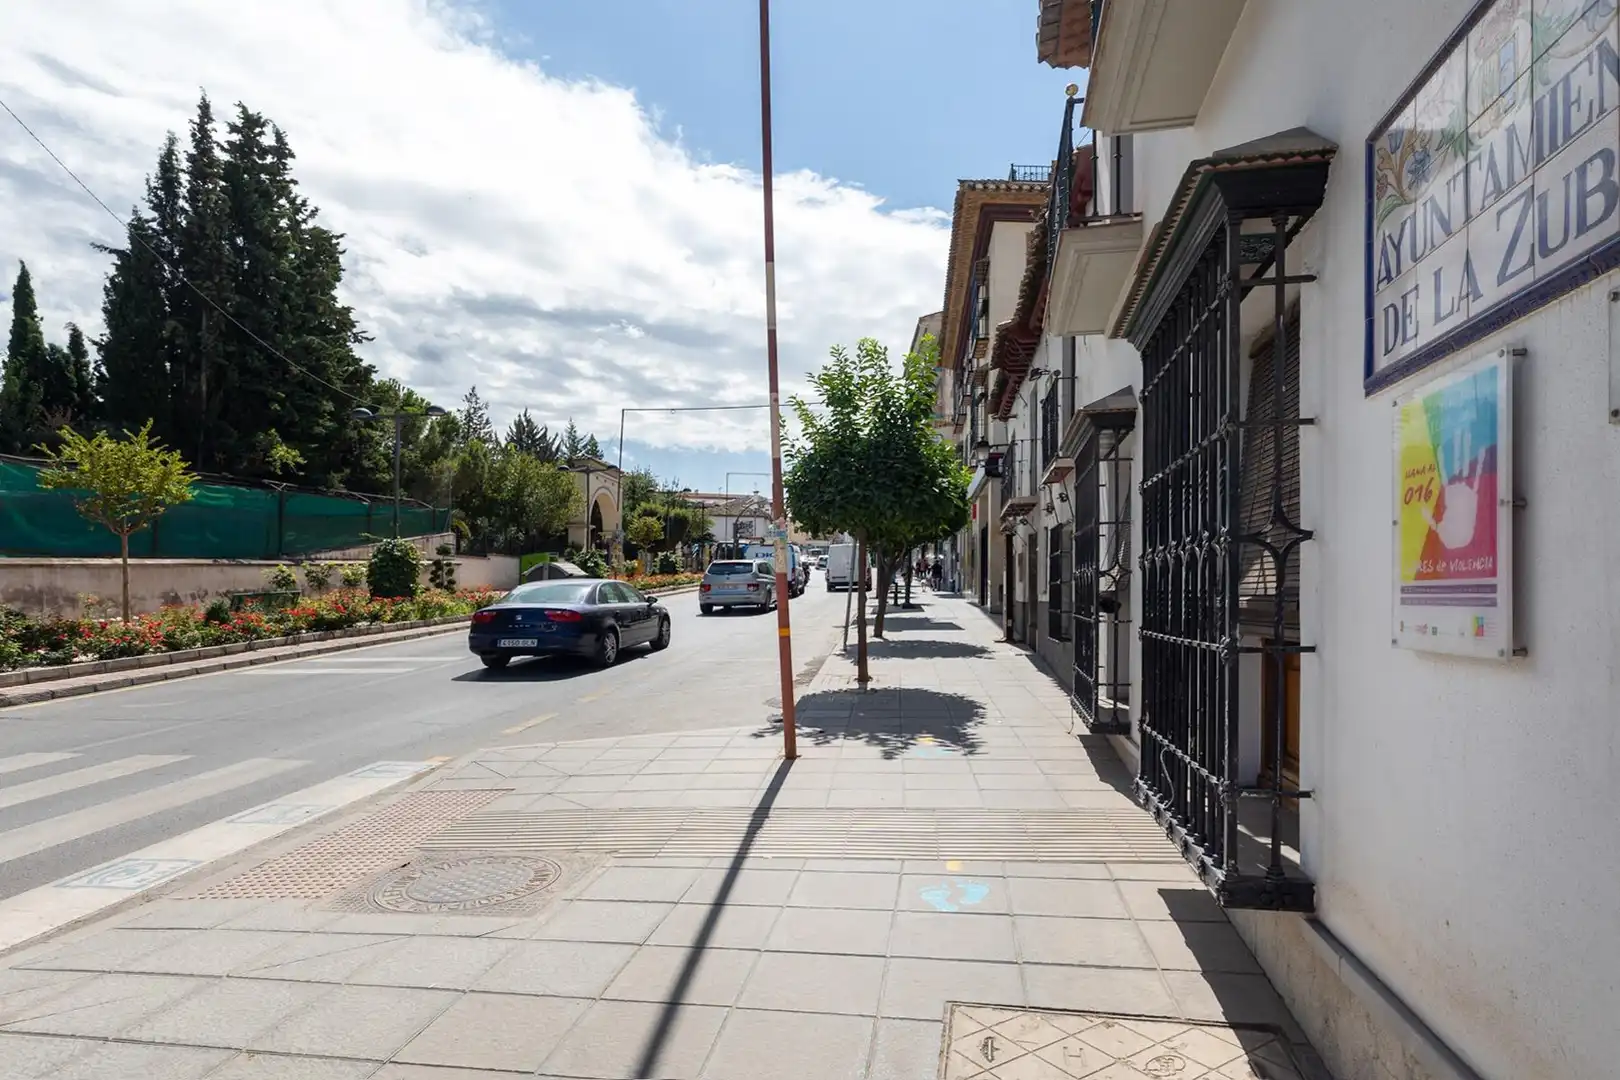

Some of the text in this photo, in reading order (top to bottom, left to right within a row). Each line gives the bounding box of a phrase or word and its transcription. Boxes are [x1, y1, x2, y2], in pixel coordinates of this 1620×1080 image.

[1383, 284, 1420, 357] DE
[1433, 247, 1484, 326] LA
[1404, 477, 1434, 505] 016
